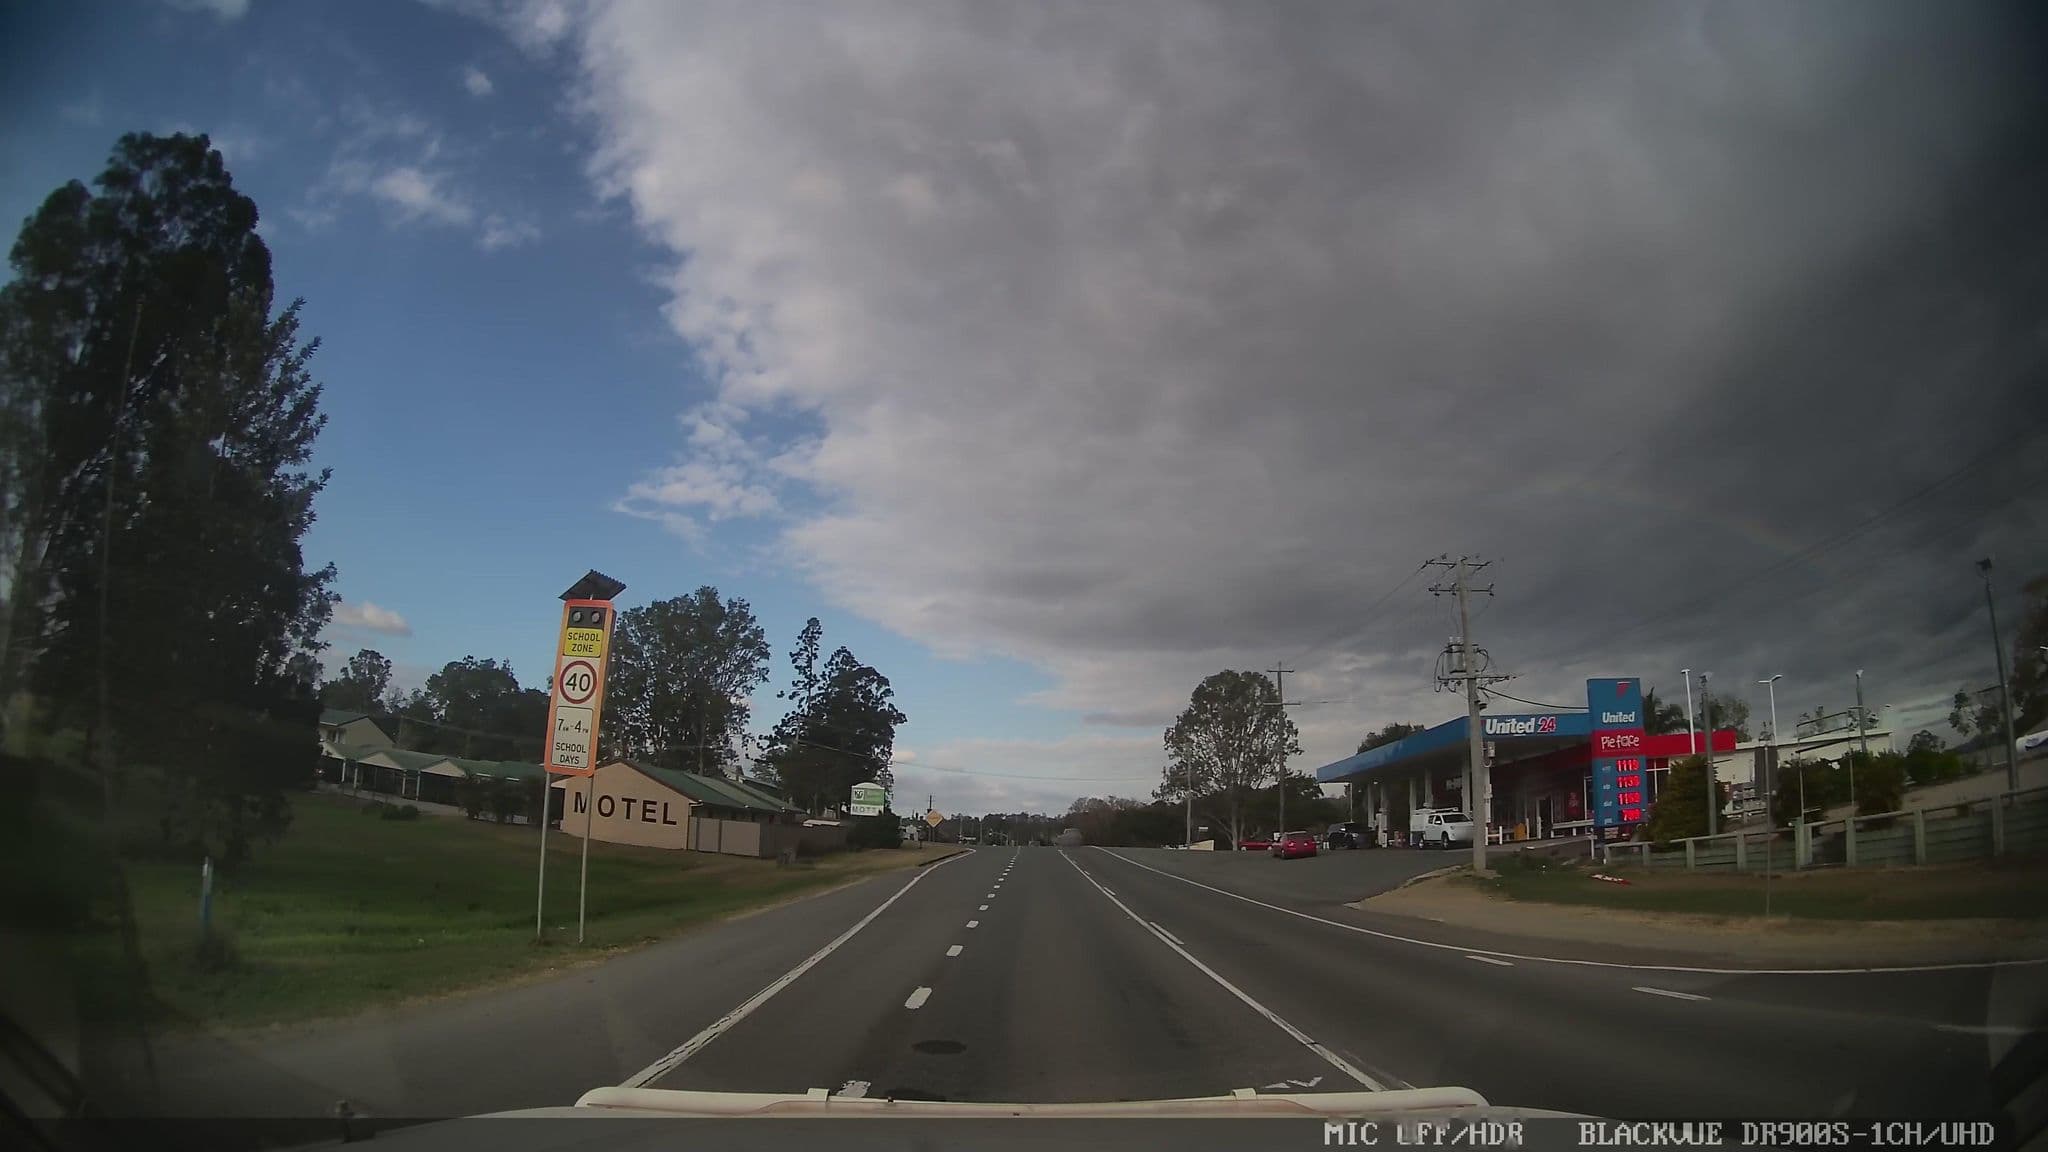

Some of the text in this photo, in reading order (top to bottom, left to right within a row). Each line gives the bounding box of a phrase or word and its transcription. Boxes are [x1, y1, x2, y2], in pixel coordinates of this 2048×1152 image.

[567, 632, 601, 642] SCHOOL
[571, 643, 594, 653] ZONE
[565, 672, 591, 692] 40
[1602, 711, 1636, 723] United
[1485, 716, 1556, 735] United 24
[555, 742, 587, 753] SCHOOL
[559, 754, 580, 765] DAYS
[573, 791, 678, 826] MOTEL
